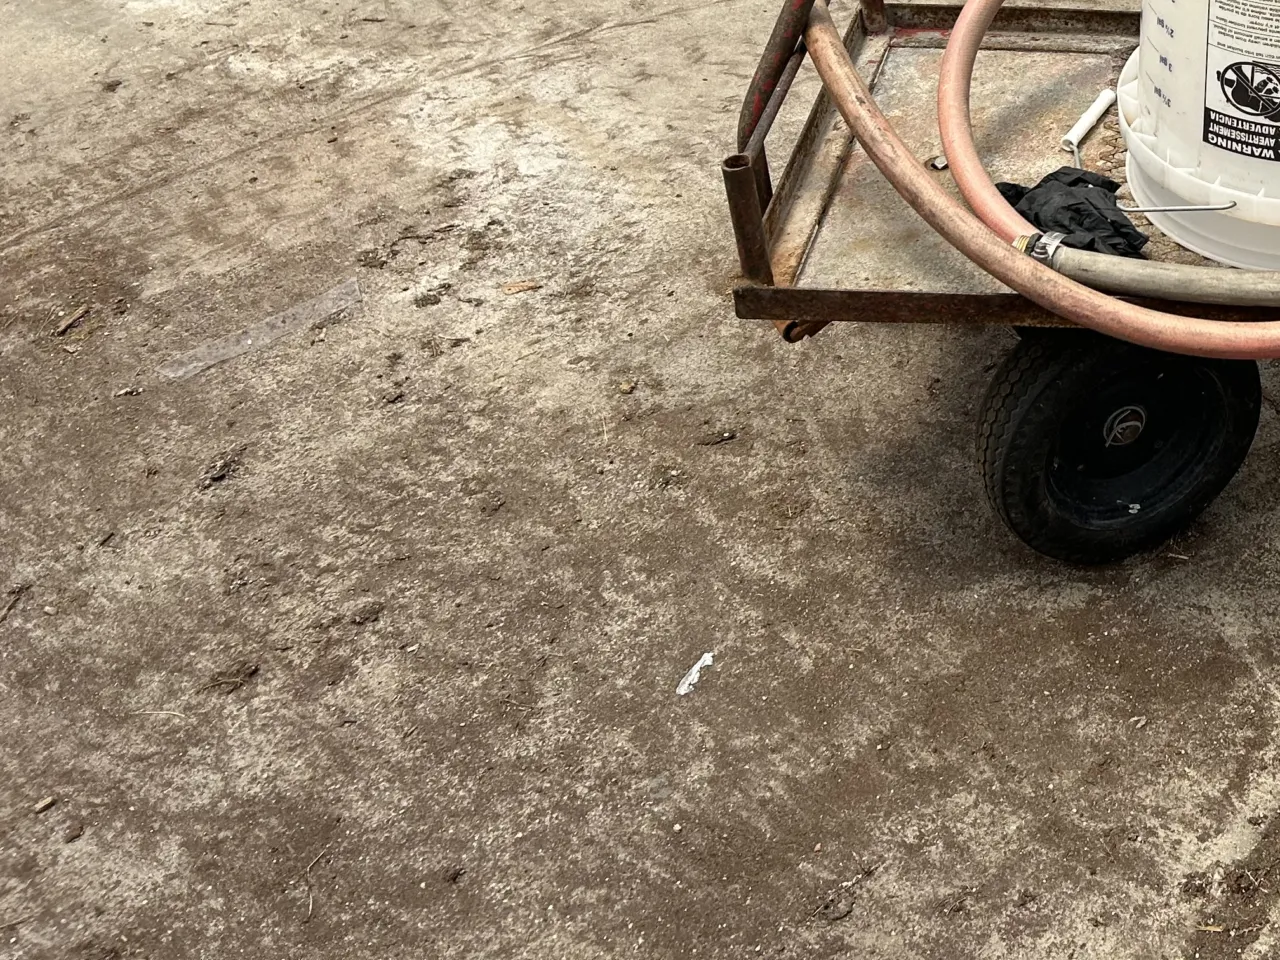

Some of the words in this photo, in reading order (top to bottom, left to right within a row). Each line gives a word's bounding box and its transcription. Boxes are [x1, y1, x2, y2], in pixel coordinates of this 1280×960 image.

[1209, 122, 1276, 147] AVERTISSEMENT
[1210, 111, 1276, 135] ADVERTENCIA
[1208, 133, 1275, 158] WARNING
